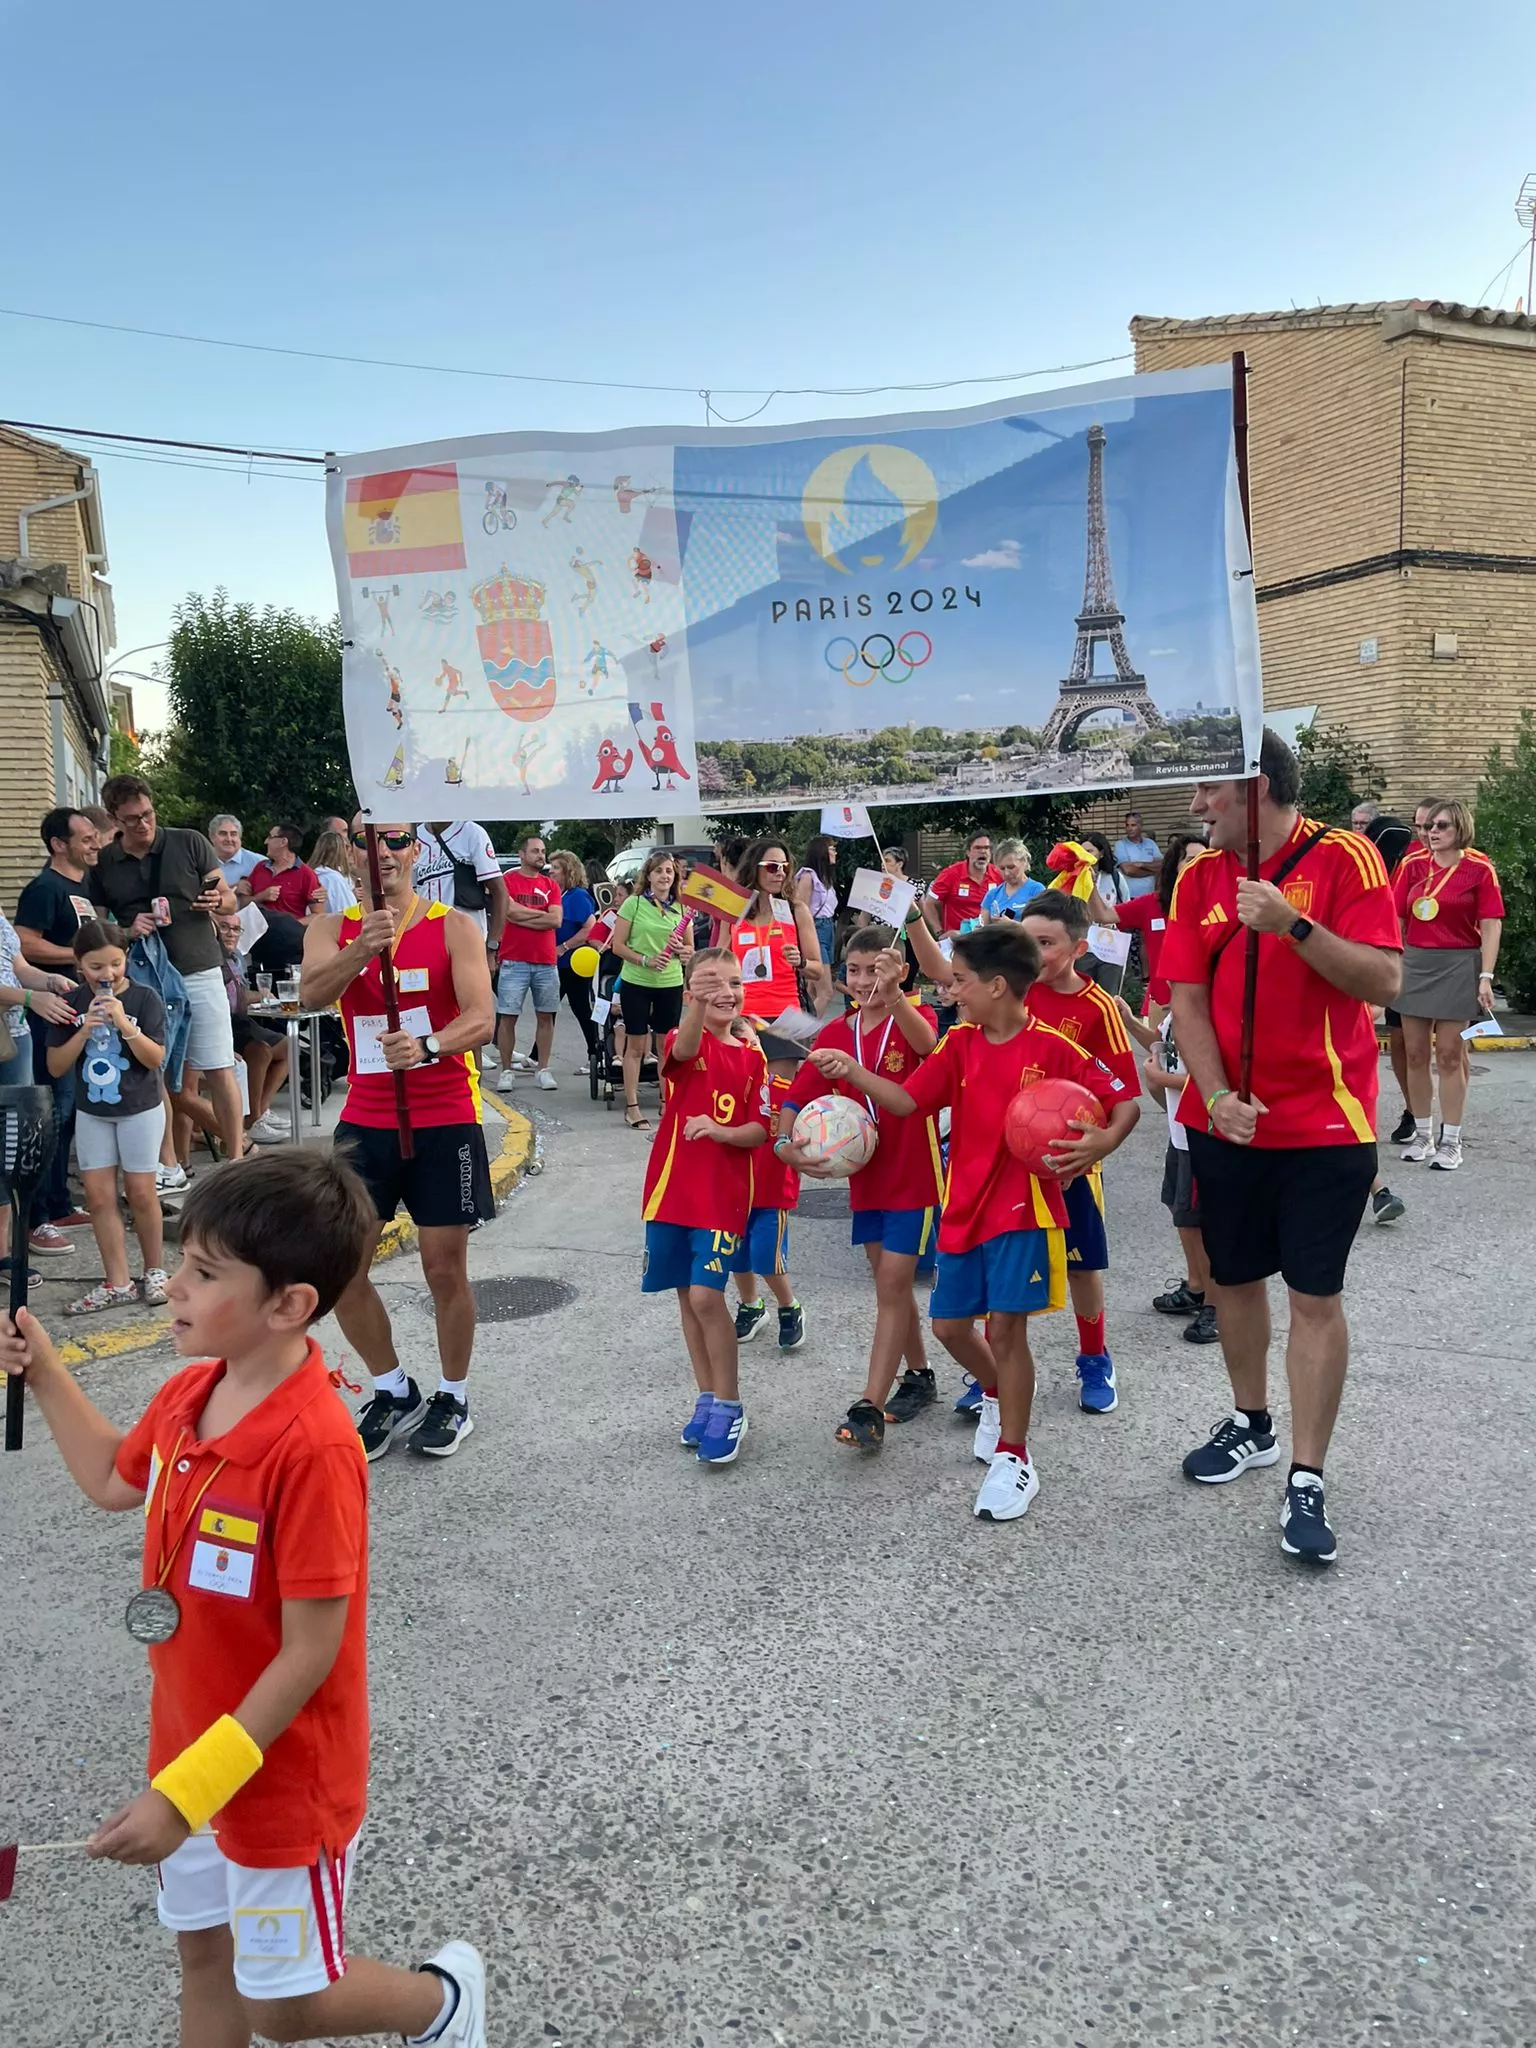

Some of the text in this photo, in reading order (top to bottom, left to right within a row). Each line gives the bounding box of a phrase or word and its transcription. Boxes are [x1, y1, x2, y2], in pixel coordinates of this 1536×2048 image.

[887, 586, 981, 615] 2024
[1156, 761, 1229, 775] Revista Semanal
[712, 1089, 736, 1124] 19
[458, 1143, 475, 1213] Joma
